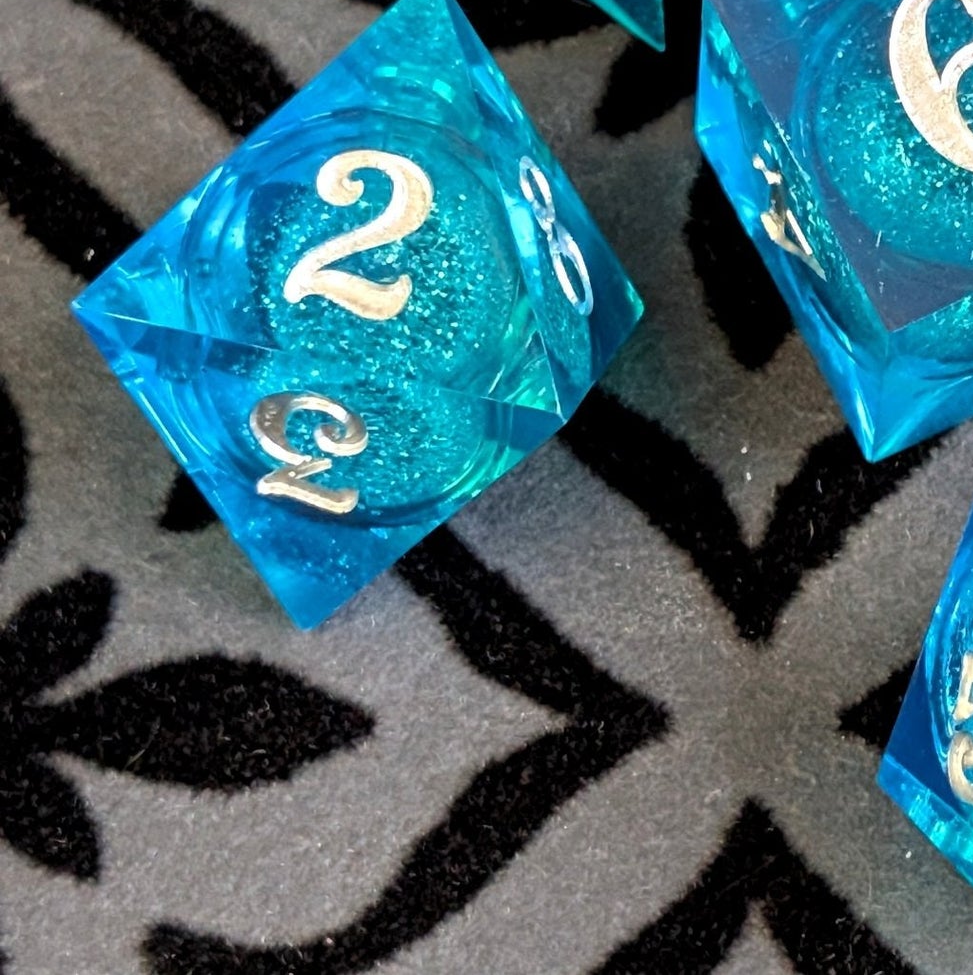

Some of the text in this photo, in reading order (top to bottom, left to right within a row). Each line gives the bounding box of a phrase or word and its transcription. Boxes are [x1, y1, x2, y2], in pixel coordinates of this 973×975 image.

[282, 149, 434, 321] 2
[518, 155, 594, 317] 8
[249, 390, 369, 515] 3
